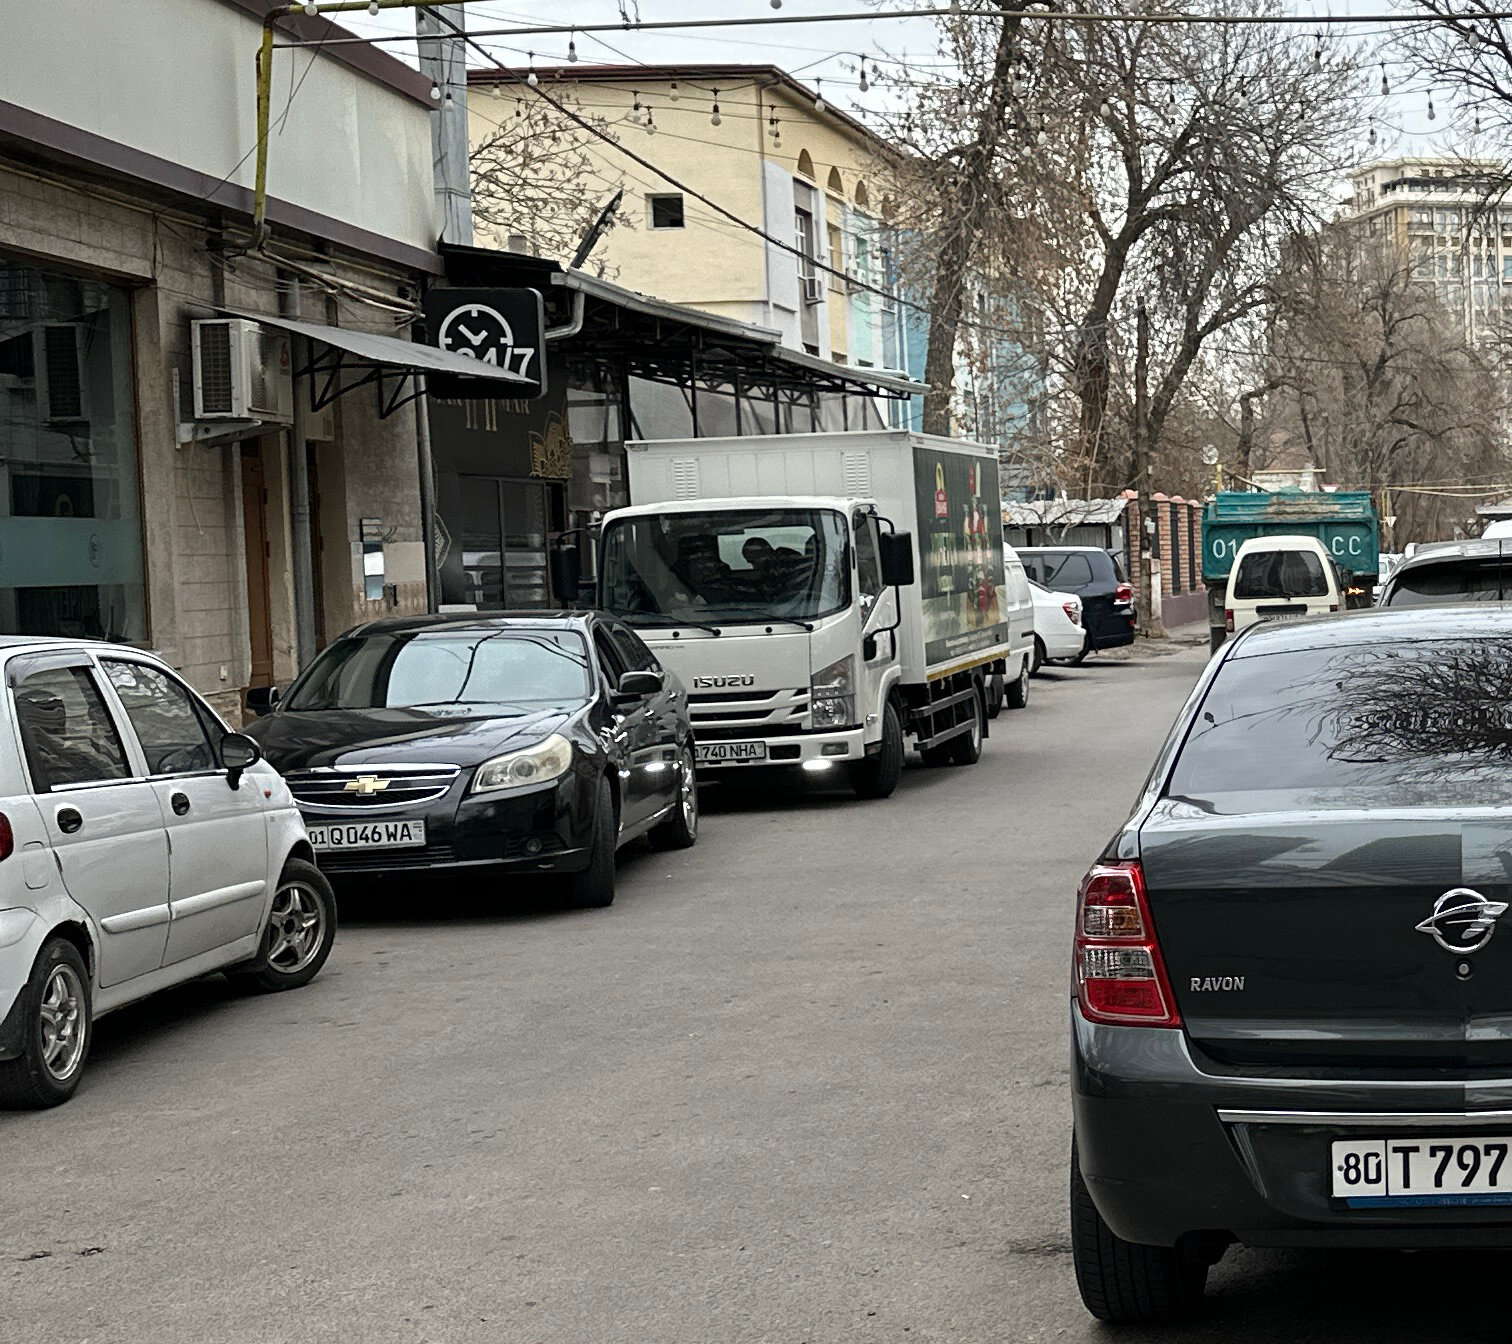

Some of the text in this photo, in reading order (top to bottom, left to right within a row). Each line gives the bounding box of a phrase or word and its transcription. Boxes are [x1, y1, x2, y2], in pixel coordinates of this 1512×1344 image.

[693, 673, 755, 690] ISUZU
[308, 830, 327, 845] 01
[1190, 976, 1245, 992] RAVON
[1343, 1151, 1382, 1185] 80
